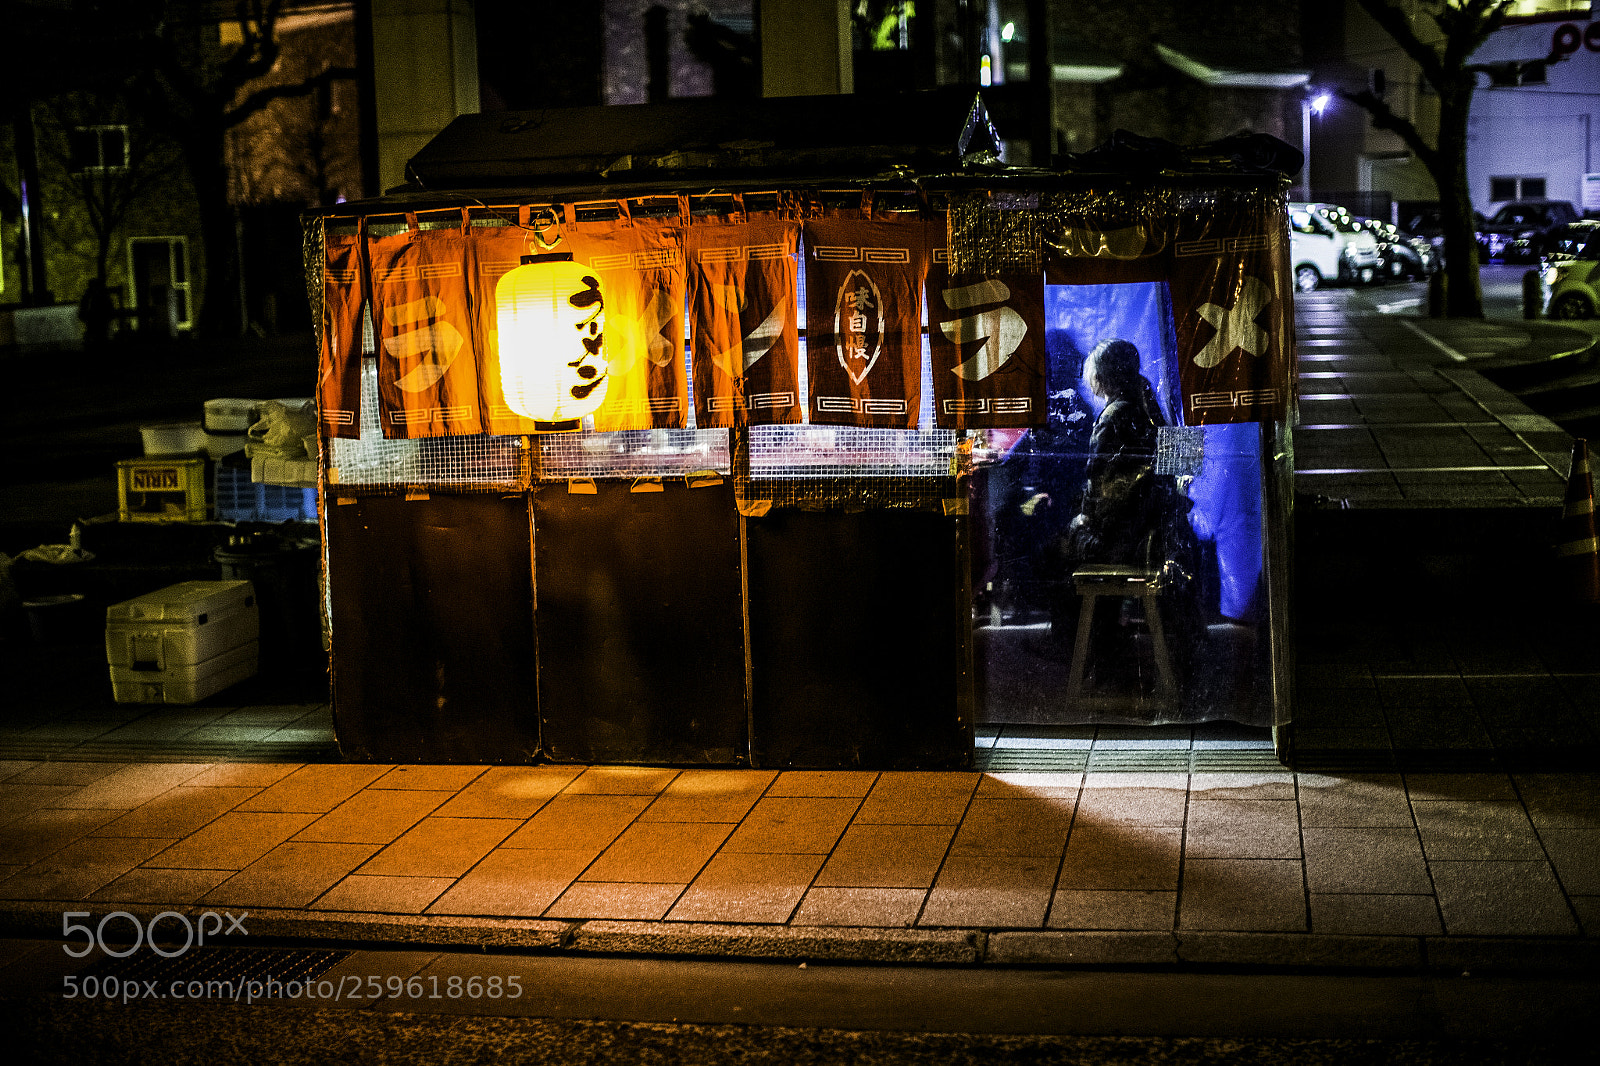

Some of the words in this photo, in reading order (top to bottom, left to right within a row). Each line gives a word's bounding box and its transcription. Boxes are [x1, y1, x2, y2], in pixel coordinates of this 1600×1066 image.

[568, 275, 608, 399] ラーメン
[845, 286, 875, 361] 味自慢
[134, 473, 178, 488] KIRIN
